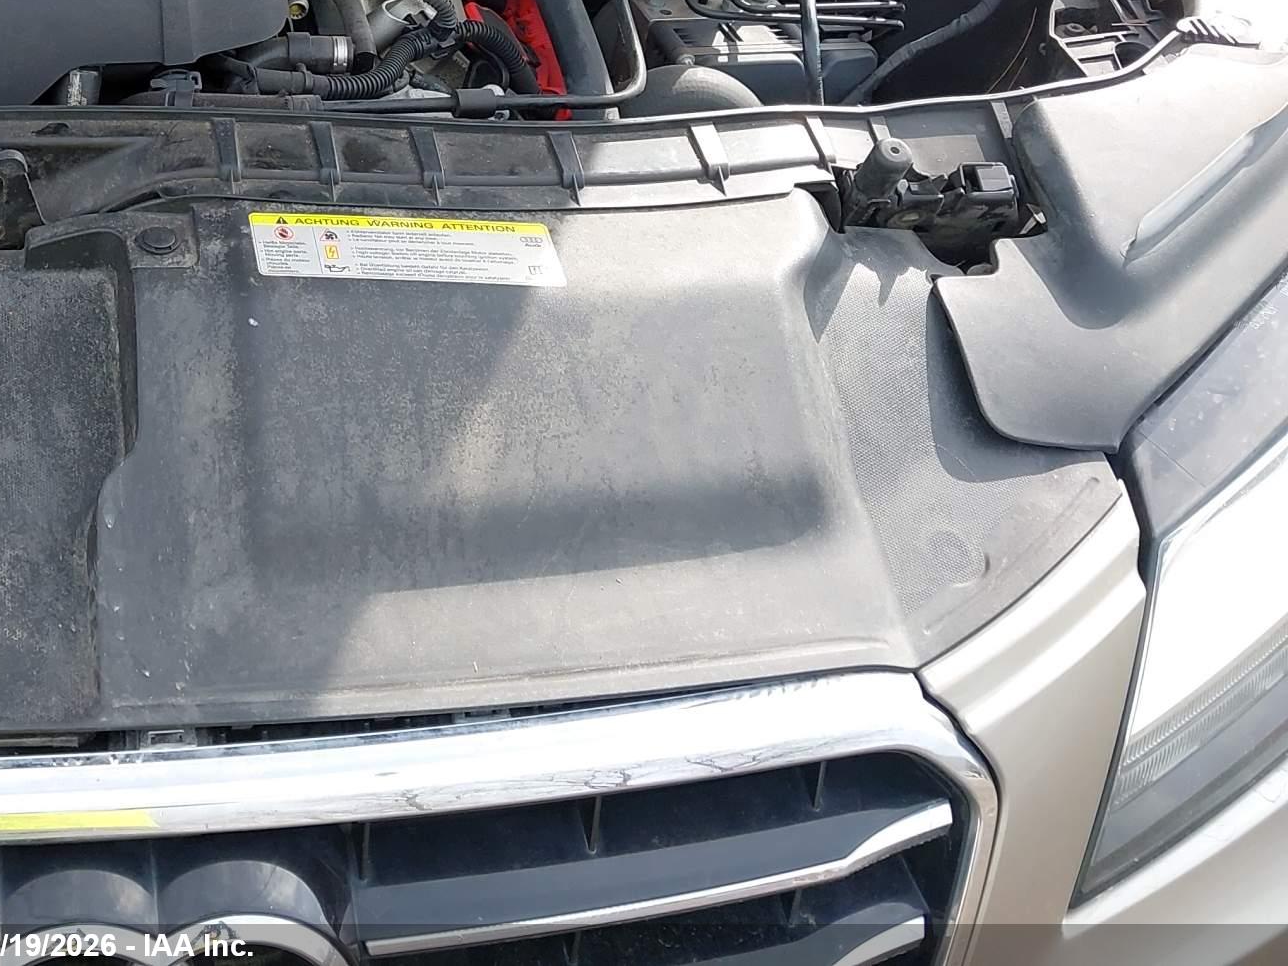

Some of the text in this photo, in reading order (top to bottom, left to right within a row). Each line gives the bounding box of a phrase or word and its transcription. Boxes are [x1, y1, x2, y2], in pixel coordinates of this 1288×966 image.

[294, 217, 516, 233] ACHTUNG WARNING ATTENTION
